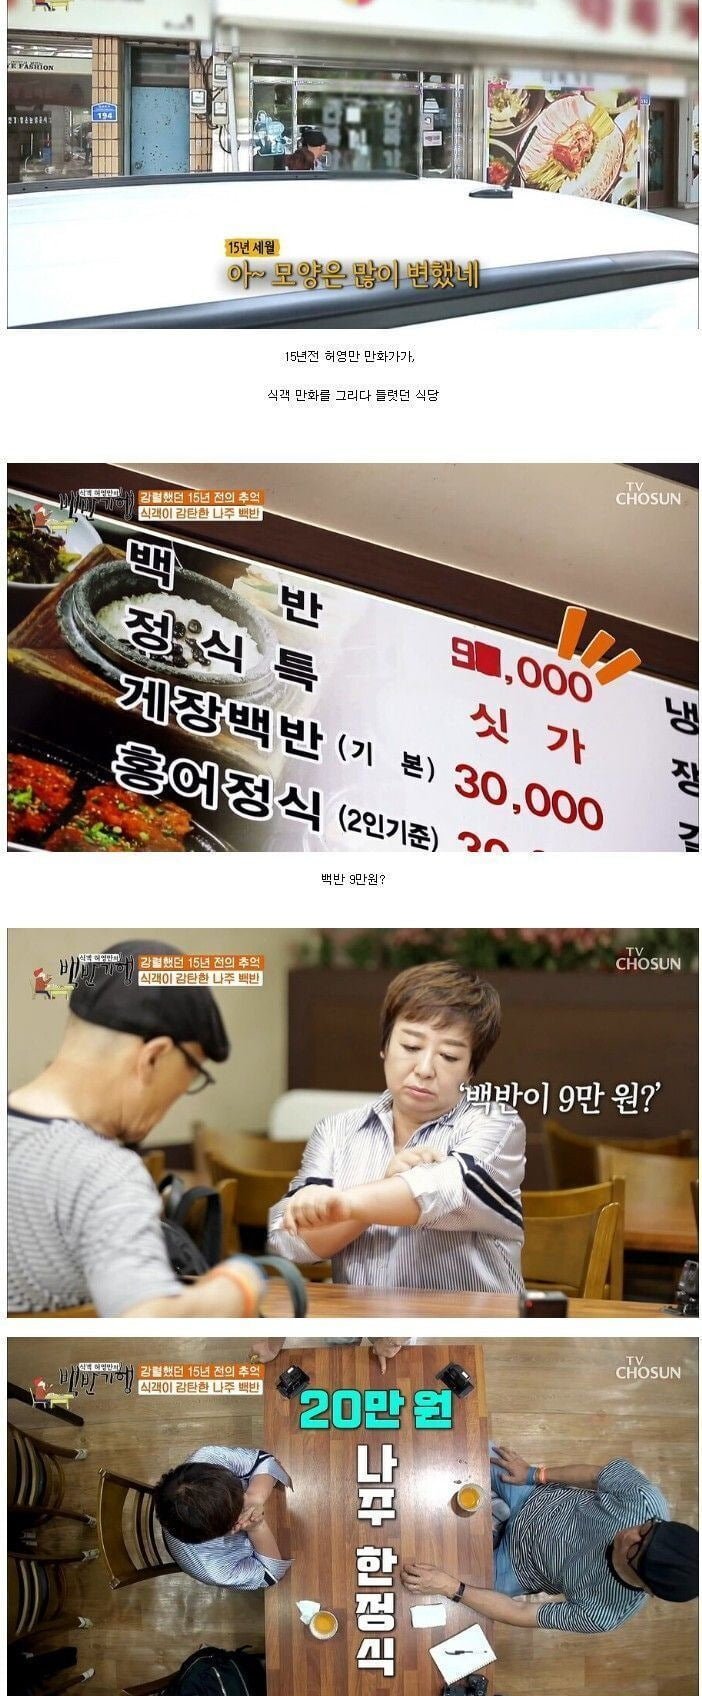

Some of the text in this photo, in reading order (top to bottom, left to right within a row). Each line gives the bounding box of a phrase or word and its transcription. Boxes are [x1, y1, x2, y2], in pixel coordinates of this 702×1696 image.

[97, 112, 113, 120] 194
[274, 648, 318, 693] 특
[451, 636, 593, 702] 9,000
[120, 677, 323, 761] 게장백반
[454, 763, 604, 831] 30,000
[115, 745, 438, 852] 홍어정식 (2인기준)
